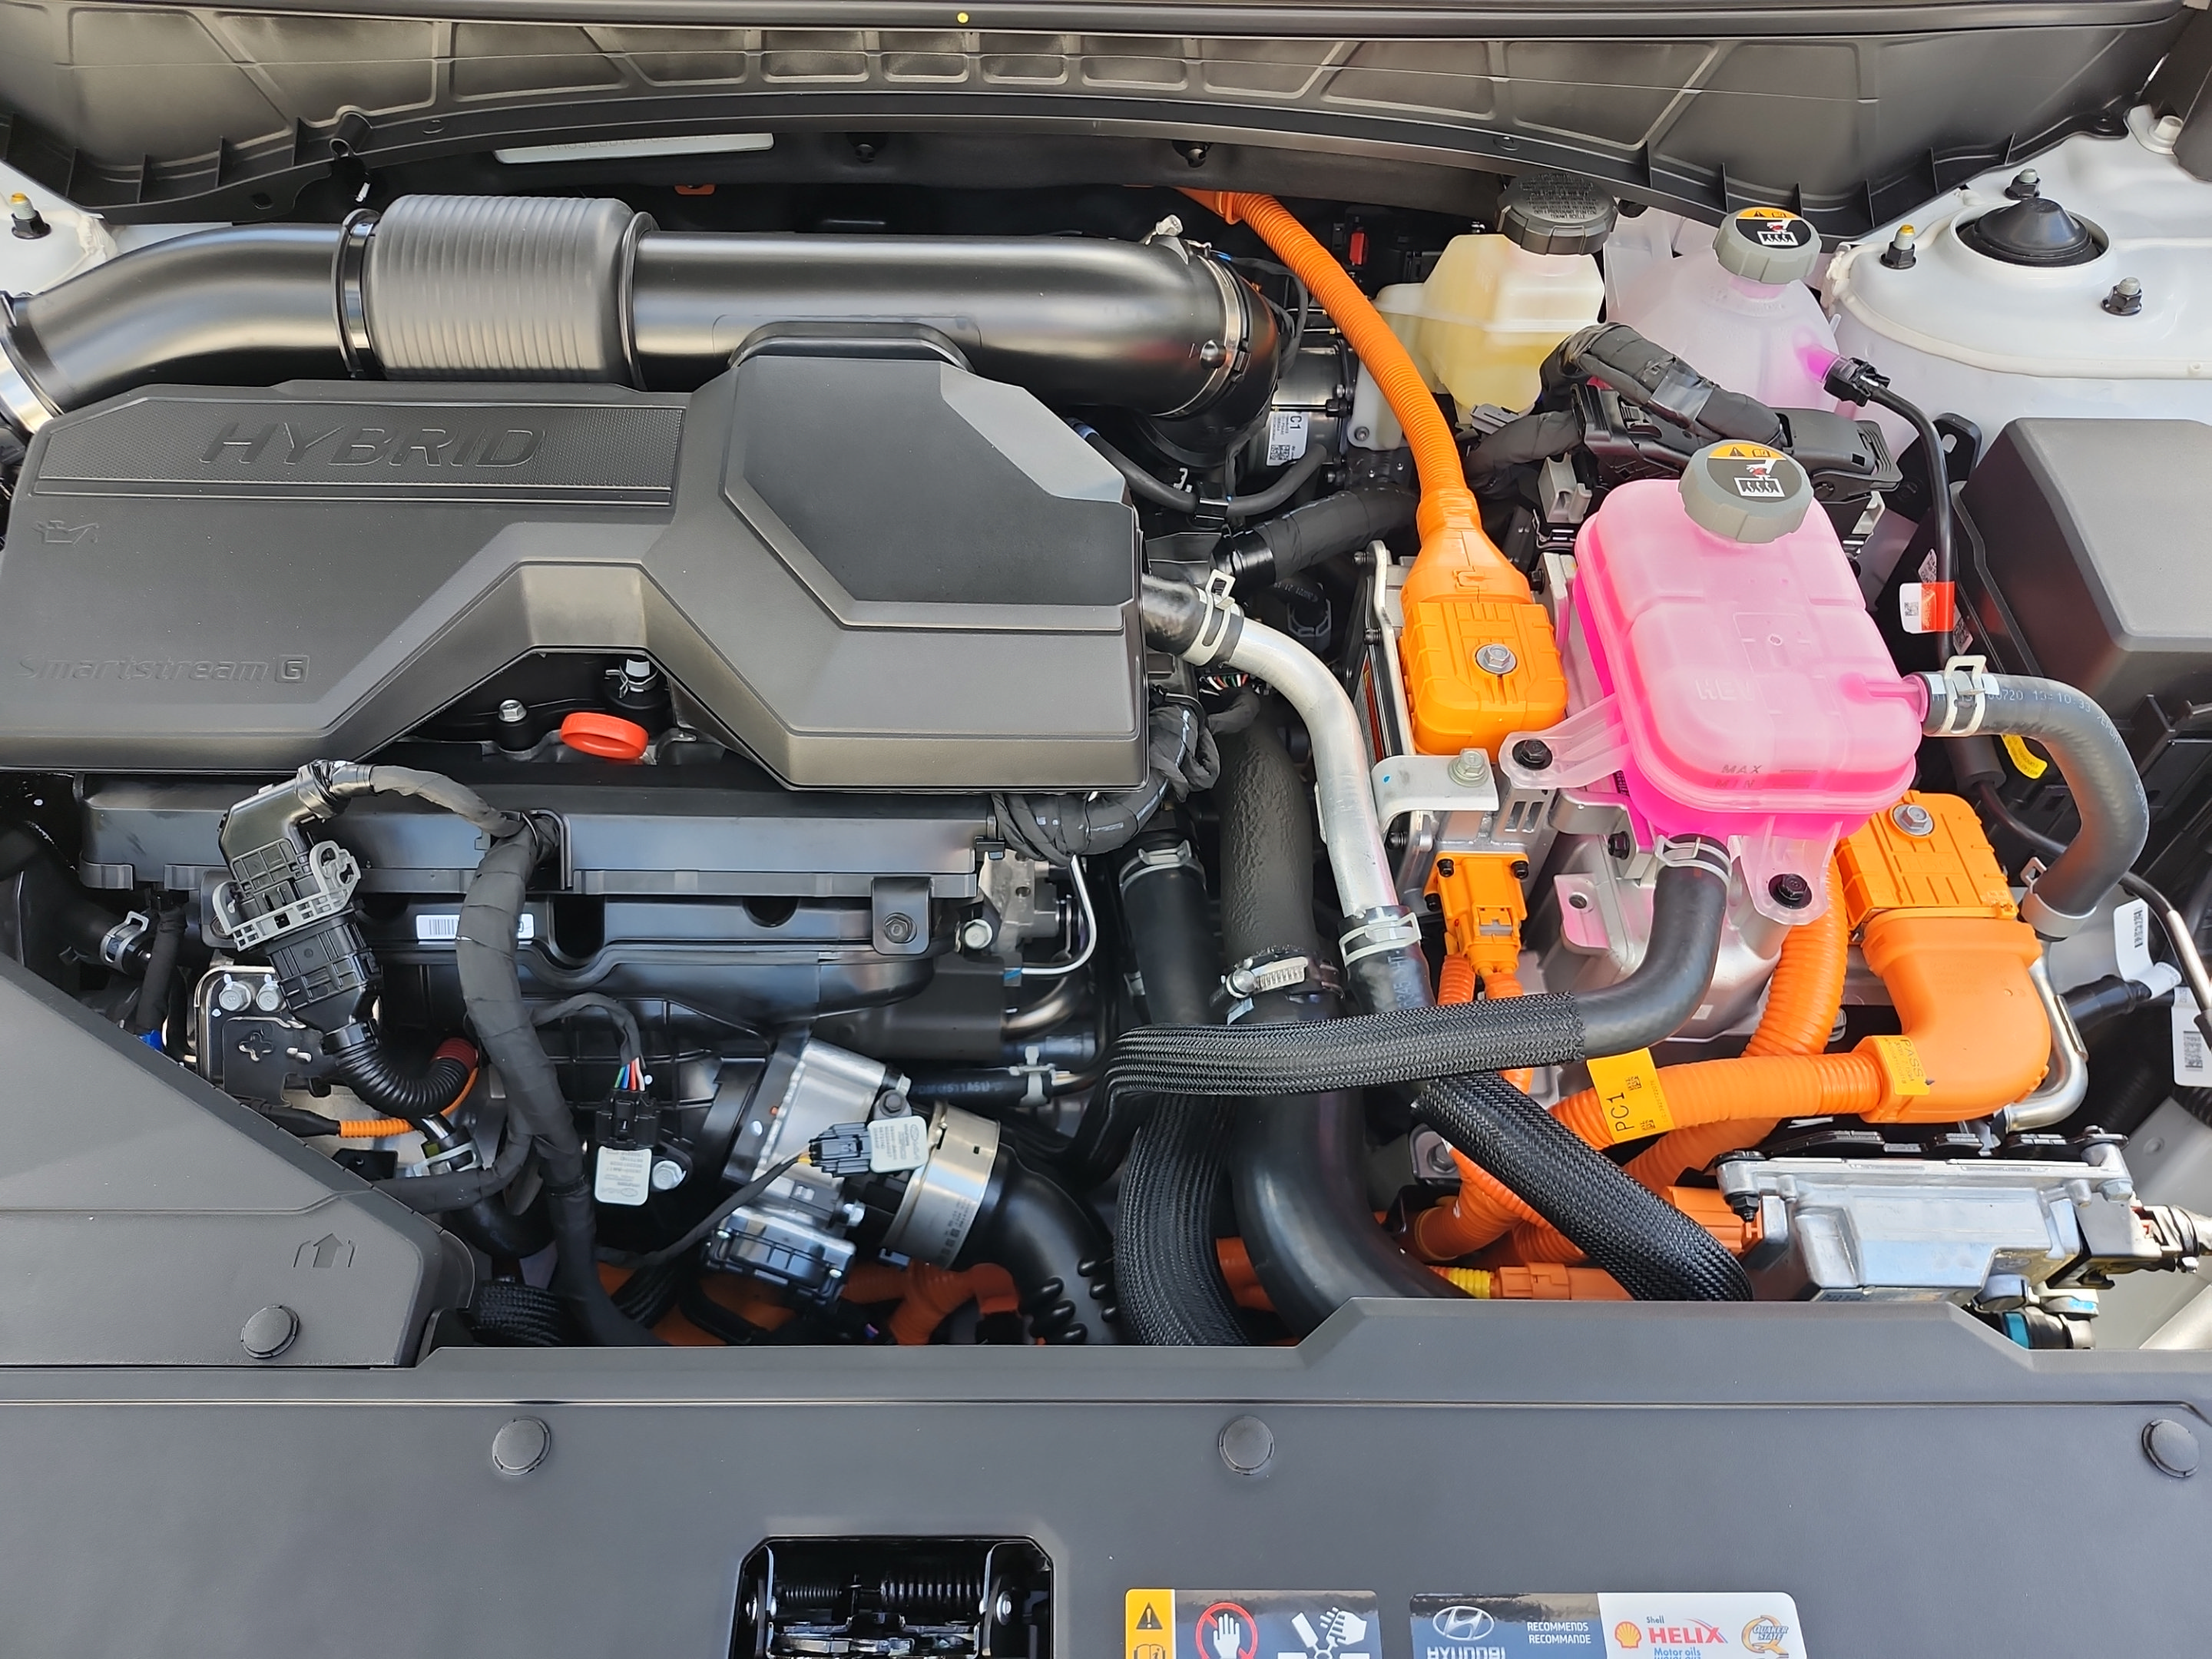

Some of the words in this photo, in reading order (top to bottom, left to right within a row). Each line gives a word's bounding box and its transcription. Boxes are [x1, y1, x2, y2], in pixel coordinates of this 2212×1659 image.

[1290, 416, 1303, 429] C1
[199, 422, 546, 467] HYBRID
[18, 656, 269, 680] Smartstream
[278, 657, 307, 682] G
[1695, 678, 1754, 701] HEV
[1720, 764, 1763, 774] MAX
[1714, 779, 1756, 789] MIN
[1900, 1038, 1924, 1078] PASS
[1606, 1092, 1635, 1132] PC1
[1646, 1614, 1665, 1624] Shell
[1527, 1621, 1589, 1632] RECOMMENDS
[1753, 1624, 1790, 1634] QUAKER
[1528, 1634, 1591, 1644] RECOMMANDE
[1647, 1627, 1725, 1644] HELIX
[1654, 1647, 1683, 1657] Motor
[1684, 1647, 1701, 1657] oils
